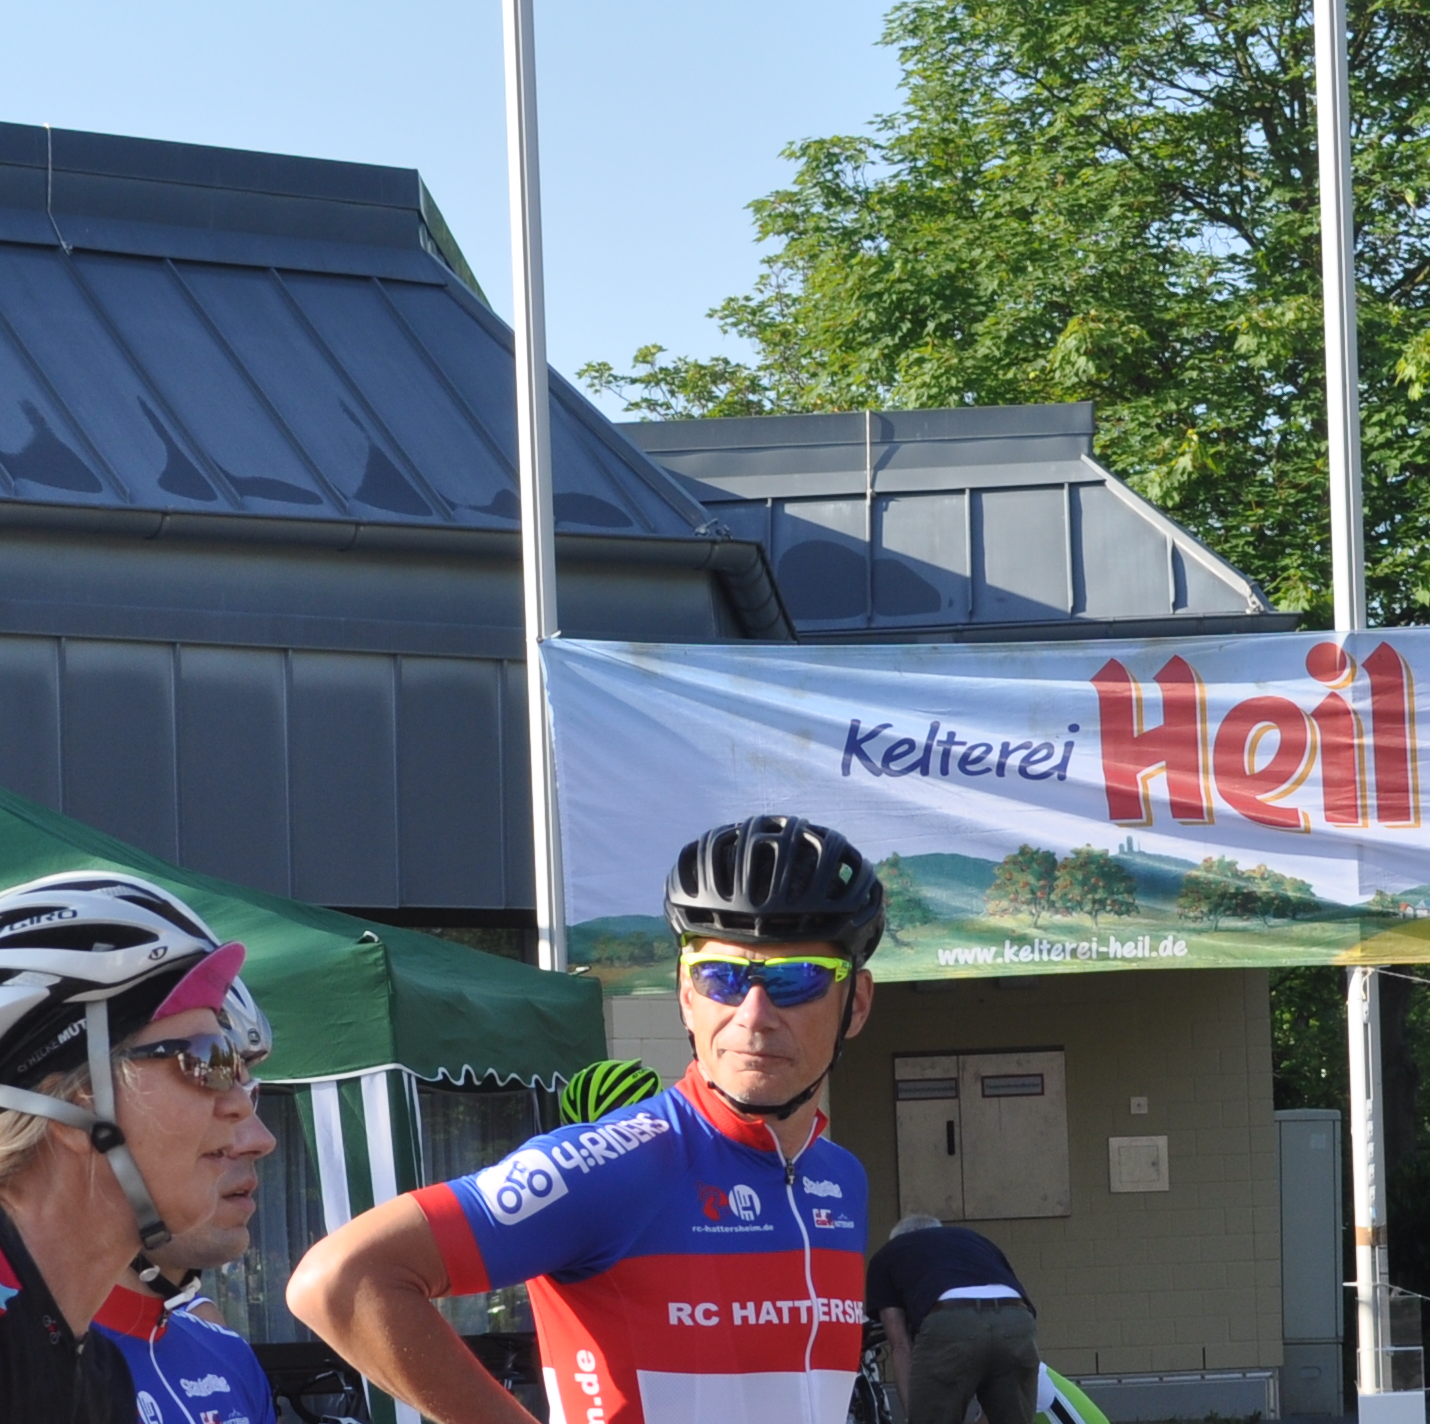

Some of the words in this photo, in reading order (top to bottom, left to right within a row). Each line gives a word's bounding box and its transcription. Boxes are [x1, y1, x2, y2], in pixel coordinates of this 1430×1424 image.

[841, 719, 1080, 781] Kelterei
[1090, 641, 1423, 834] Heil
[937, 935, 1188, 968] www.kelterei-heil.de
[692, 1223, 774, 1234] rc-hattersheim.de
[668, 1302, 720, 1327] RC
